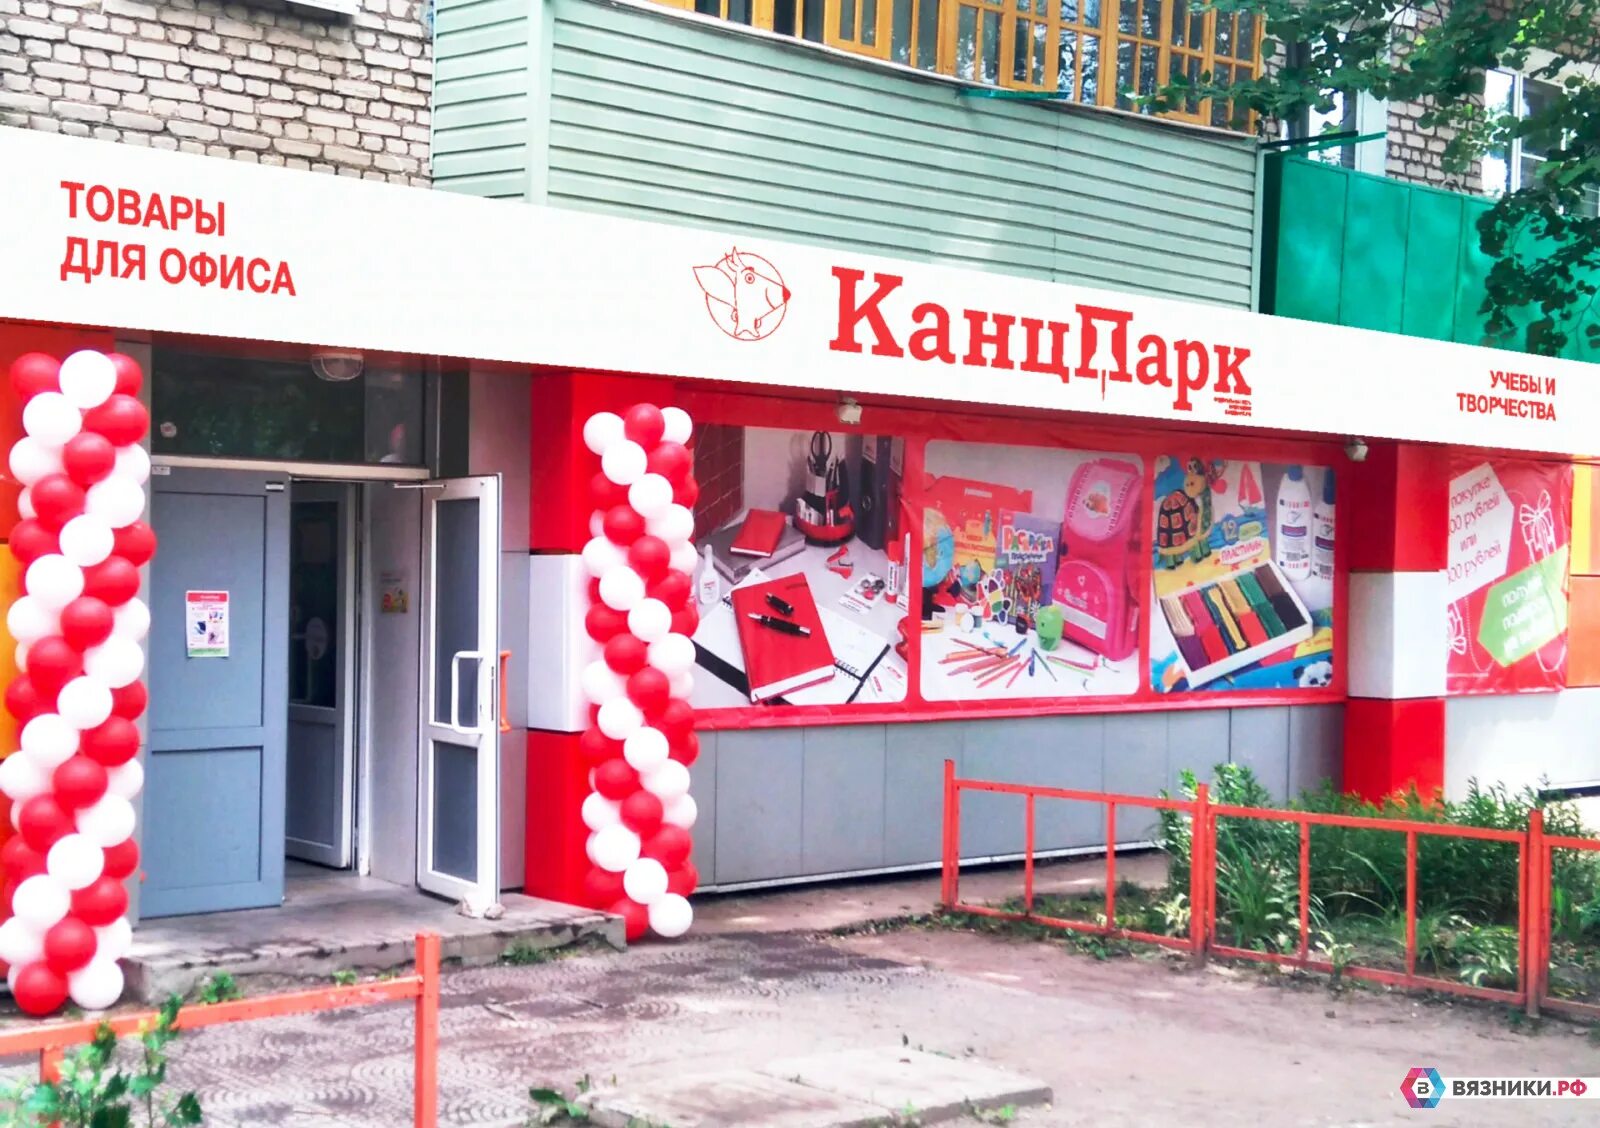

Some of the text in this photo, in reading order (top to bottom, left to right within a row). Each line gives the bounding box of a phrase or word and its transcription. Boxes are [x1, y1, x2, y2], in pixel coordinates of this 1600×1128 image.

[60, 180, 225, 236] ТОВАРЫ
[60, 236, 297, 296] ДЛЯ ОФИСА
[828, 265, 1252, 412] КанцПарк
[1456, 392, 1556, 421] ТВОРЧЕСТВА
[1489, 370, 1556, 396] УЧЕБЫ И
